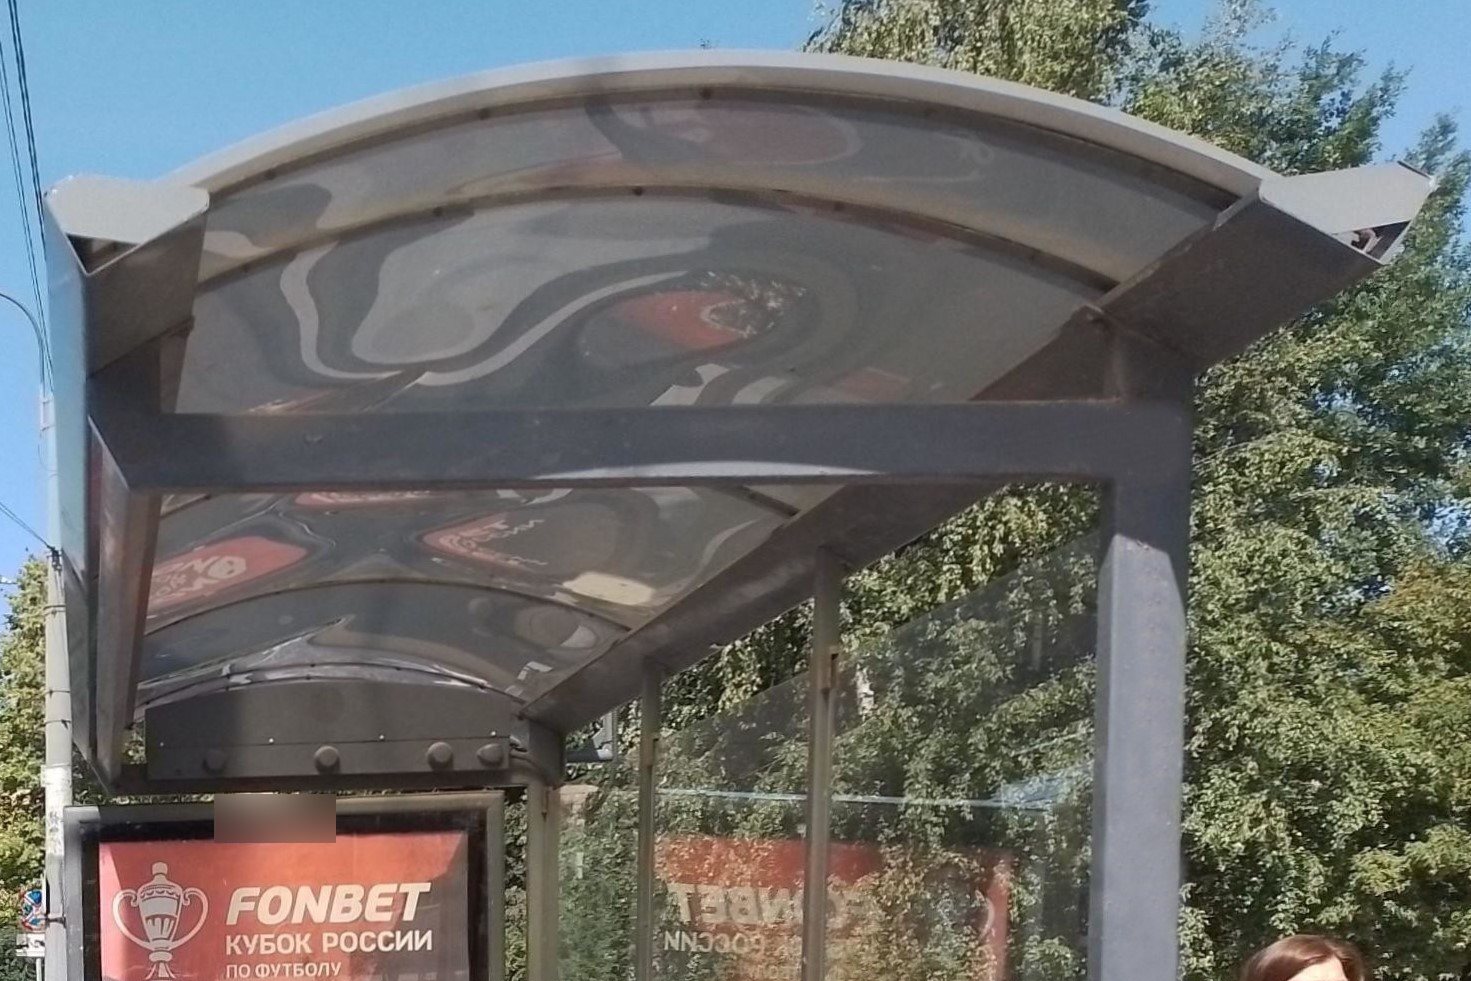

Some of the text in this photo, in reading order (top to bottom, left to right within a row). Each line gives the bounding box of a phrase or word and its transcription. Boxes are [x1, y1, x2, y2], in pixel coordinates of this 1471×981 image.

[226, 882, 432, 925] FONBET
[226, 929, 433, 956] КУБОК РОССИИ
[226, 961, 342, 979] ПО ФУТБОЛУ
